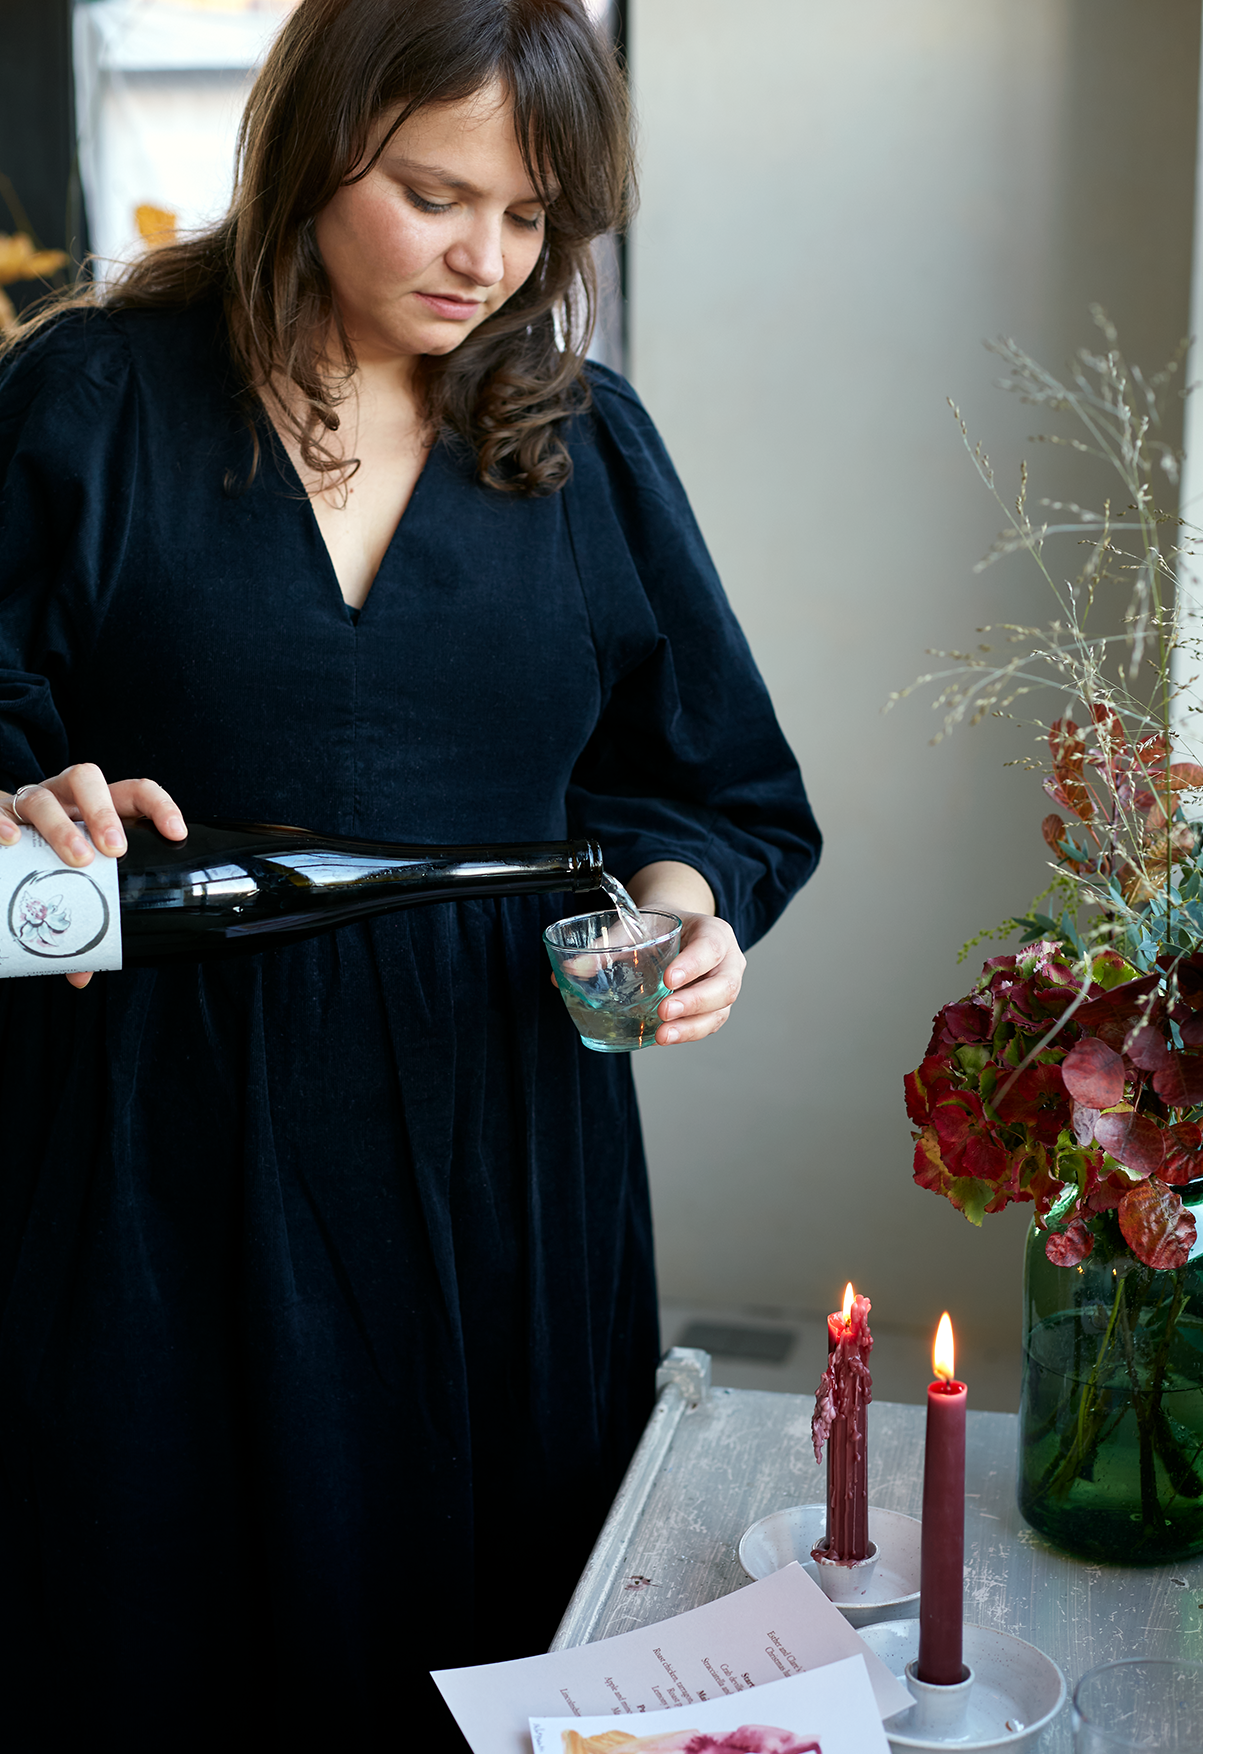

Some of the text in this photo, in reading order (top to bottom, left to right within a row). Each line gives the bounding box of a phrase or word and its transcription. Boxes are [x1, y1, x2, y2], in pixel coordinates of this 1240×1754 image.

[652, 1647, 666, 1663] Roast
[767, 1630, 782, 1647] Esther
[779, 1647, 791, 1657] and
[720, 1663, 733, 1677] Crab
[765, 1646, 785, 1671] Christmas
[701, 1657, 725, 1687] Stracciatella
[604, 1677, 619, 1692] Apple
[614, 1691, 627, 1702] and
[651, 1685, 669, 1706] Lemony
[666, 1687, 680, 1703] Roast
